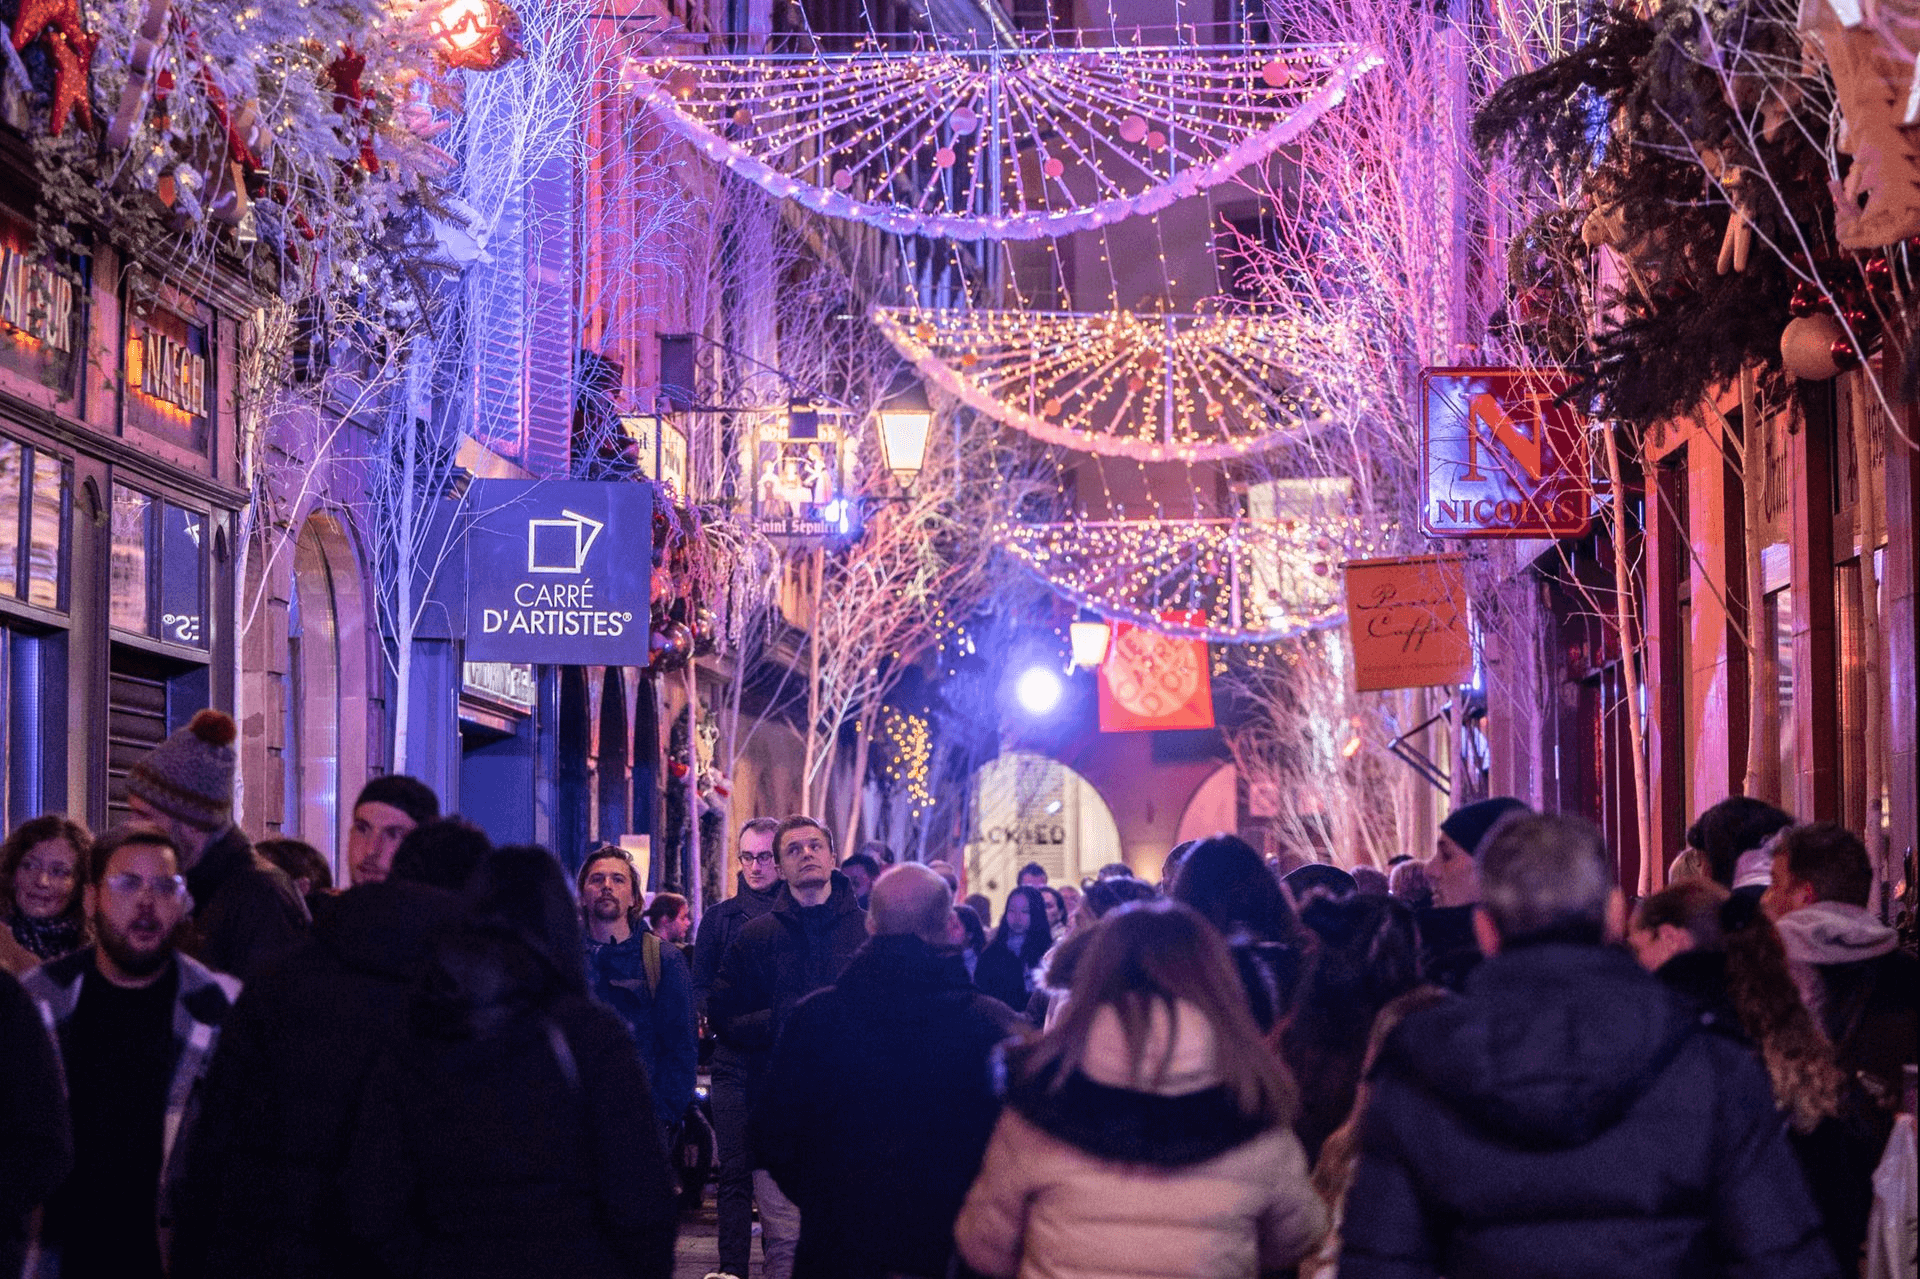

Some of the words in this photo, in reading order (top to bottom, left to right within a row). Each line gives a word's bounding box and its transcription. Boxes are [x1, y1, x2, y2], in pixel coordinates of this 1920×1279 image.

[146, 328, 208, 418] NAEGEL
[1459, 393, 1554, 481] N
[1436, 500, 1576, 524] NICOLAS
[514, 578, 594, 609] CARRÉ
